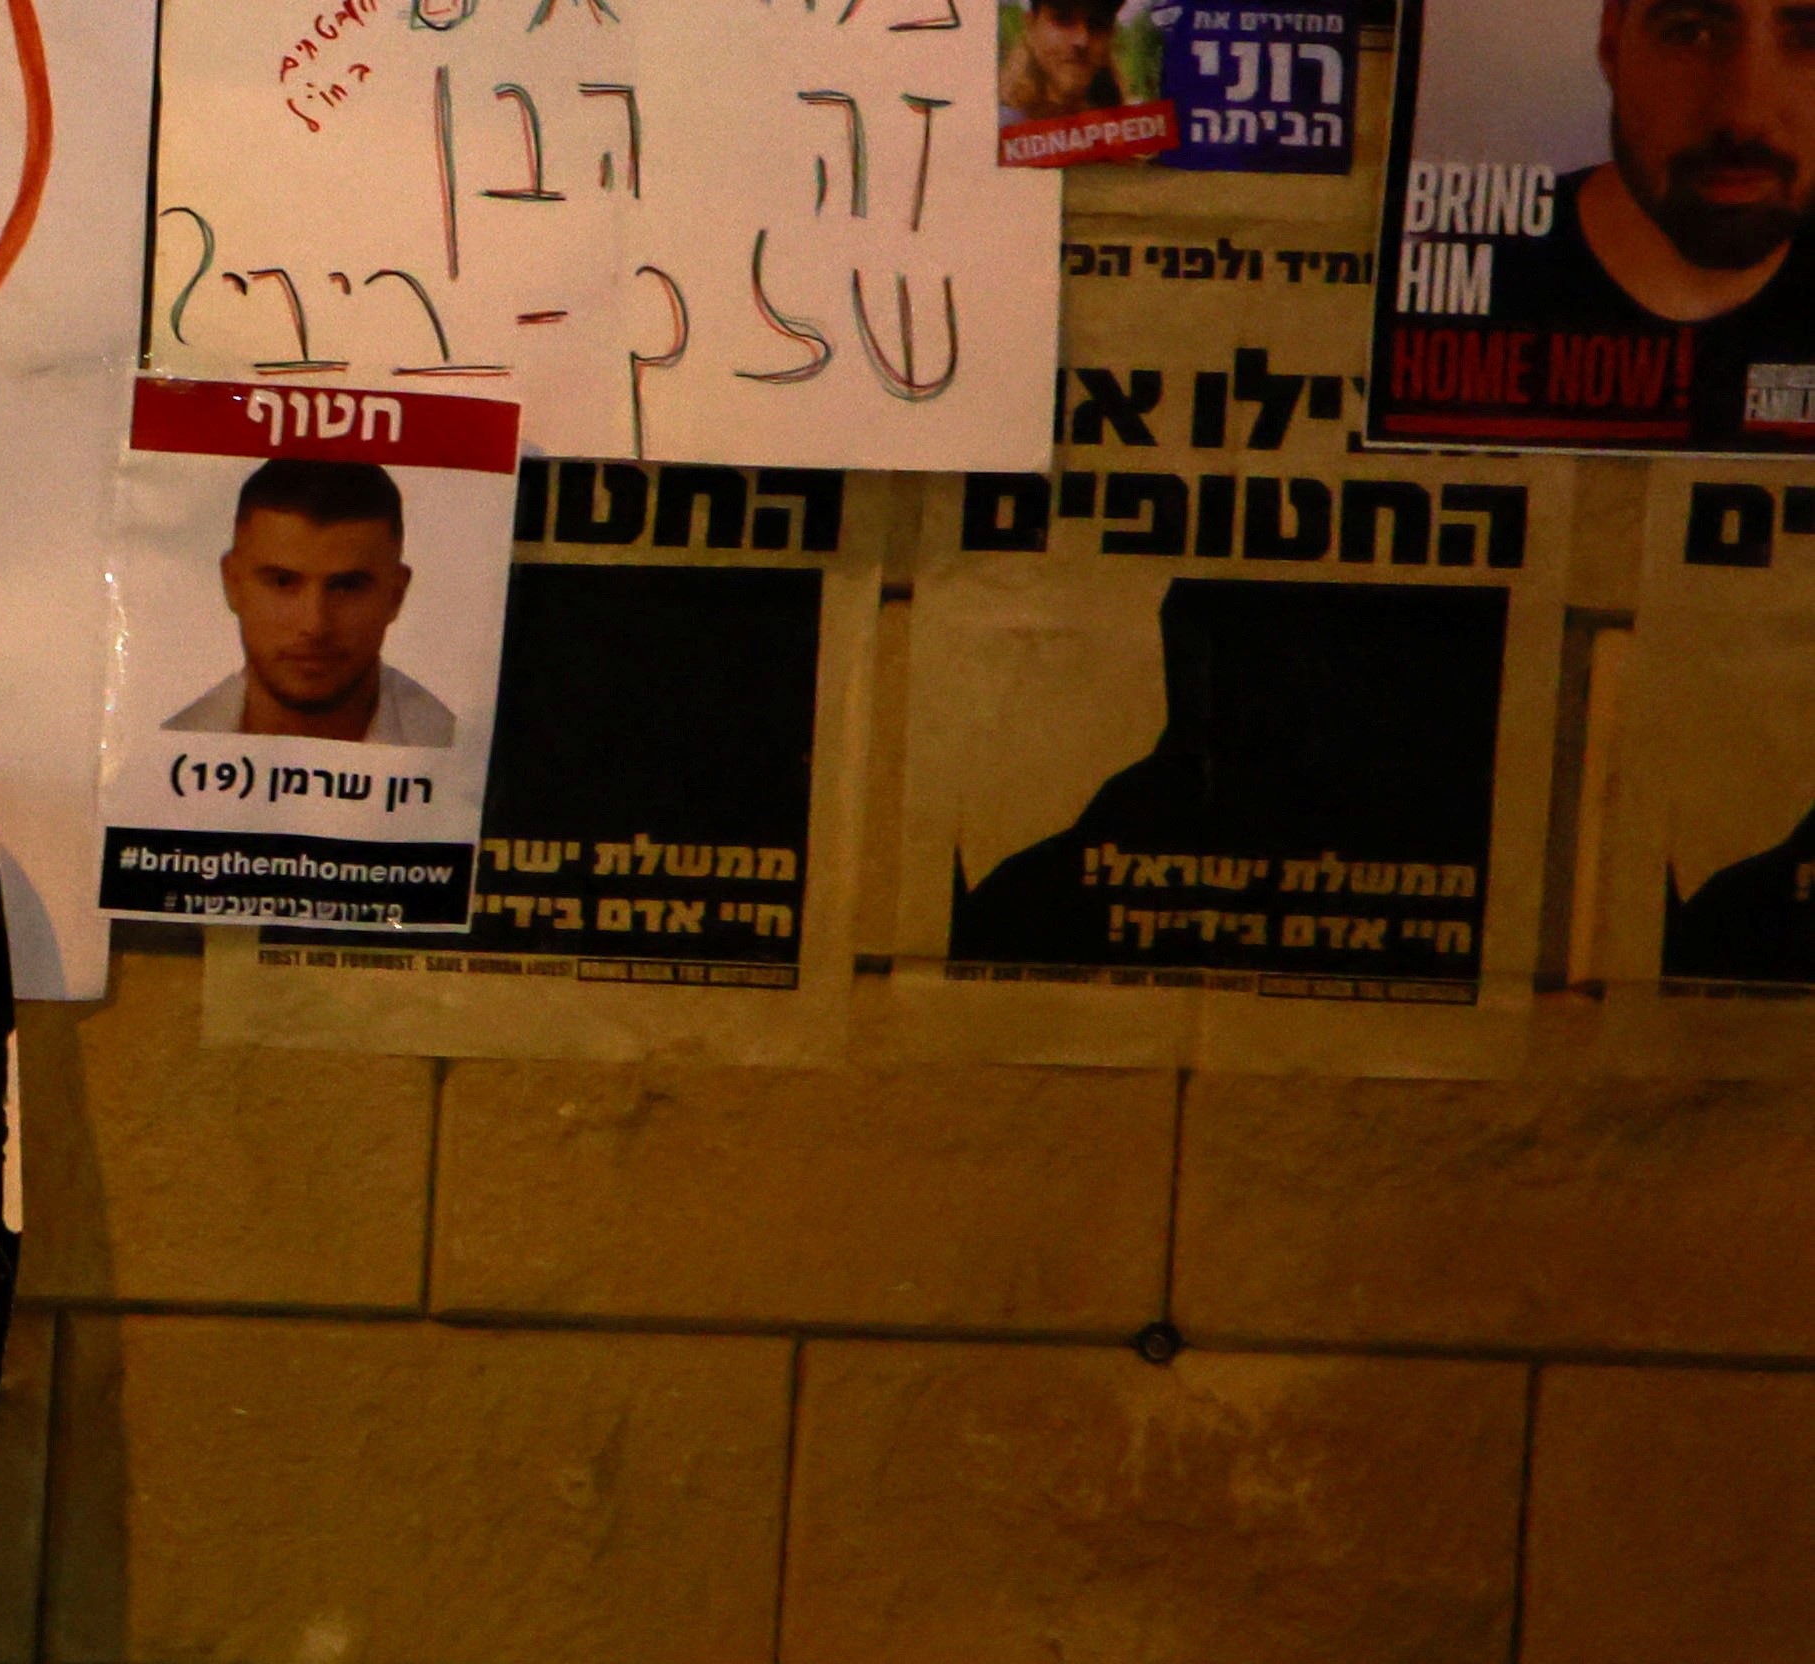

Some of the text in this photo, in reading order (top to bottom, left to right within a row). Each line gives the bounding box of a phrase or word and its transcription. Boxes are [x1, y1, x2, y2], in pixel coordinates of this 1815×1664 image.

[1193, 9, 1344, 34] מחזירים את
[1190, 39, 1345, 105] רוני
[1003, 114, 1167, 162] KIDNAPPED!
[1190, 108, 1344, 147] הביתה
[435, 66, 954, 281] זה הבן
[1404, 160, 1557, 237] BRING
[1145, 237, 1264, 282] ולפני
[1395, 241, 1494, 316] HIM
[628, 228, 959, 459] שלך
[1390, 328, 1534, 404] HOME
[1548, 326, 1697, 411] NOW!
[246, 388, 403, 447] חטוף
[961, 470, 1528, 569] החטופים
[170, 752, 433, 813] רון שרמן (19)
[119, 845, 455, 885] #bringthemhomenow
[593, 833, 797, 881] ממשלת
[1082, 842, 1477, 898] ממשלת ישראל!
[595, 897, 706, 934] אדם
[719, 901, 793, 937] חיי
[1108, 903, 1471, 954] חיי אדם בידייך!
